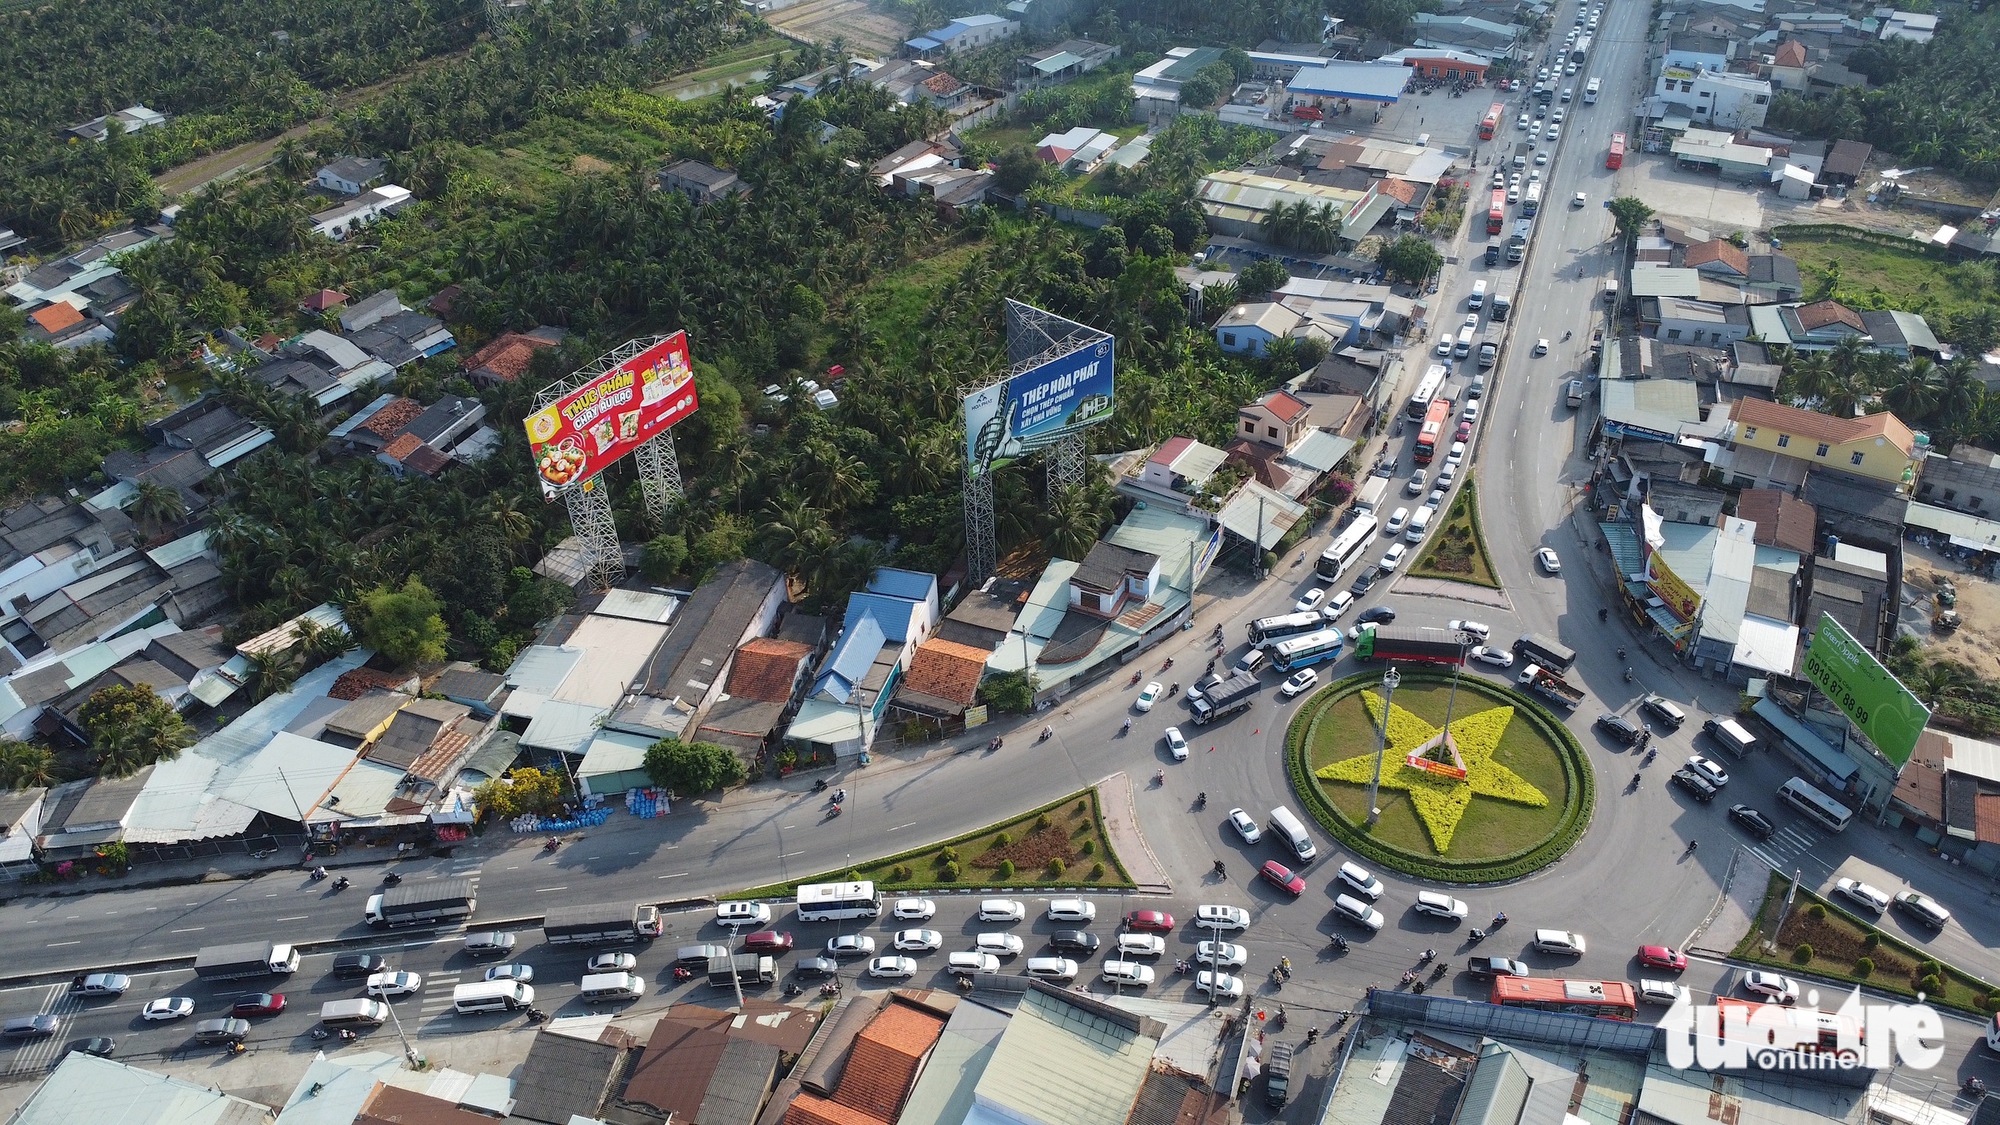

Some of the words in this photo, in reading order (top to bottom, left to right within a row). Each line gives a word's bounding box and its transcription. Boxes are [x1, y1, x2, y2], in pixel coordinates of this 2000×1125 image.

[563, 388, 598, 419] THỰC
[599, 369, 634, 397] PHẨM
[1022, 382, 1050, 407] THÉP
[1050, 373, 1072, 395] HÒA
[1073, 361, 1100, 385] PHÁT
[574, 406, 598, 429] CHAY
[614, 390, 632, 404] LẠC
[1022, 404, 1039, 418] CHỌN
[1040, 397, 1054, 411] THÉP
[1808, 658, 1830, 686] 0918
[1830, 680, 1844, 697] 87
[1843, 693, 1856, 711] 88
[1856, 706, 1869, 724] 99
